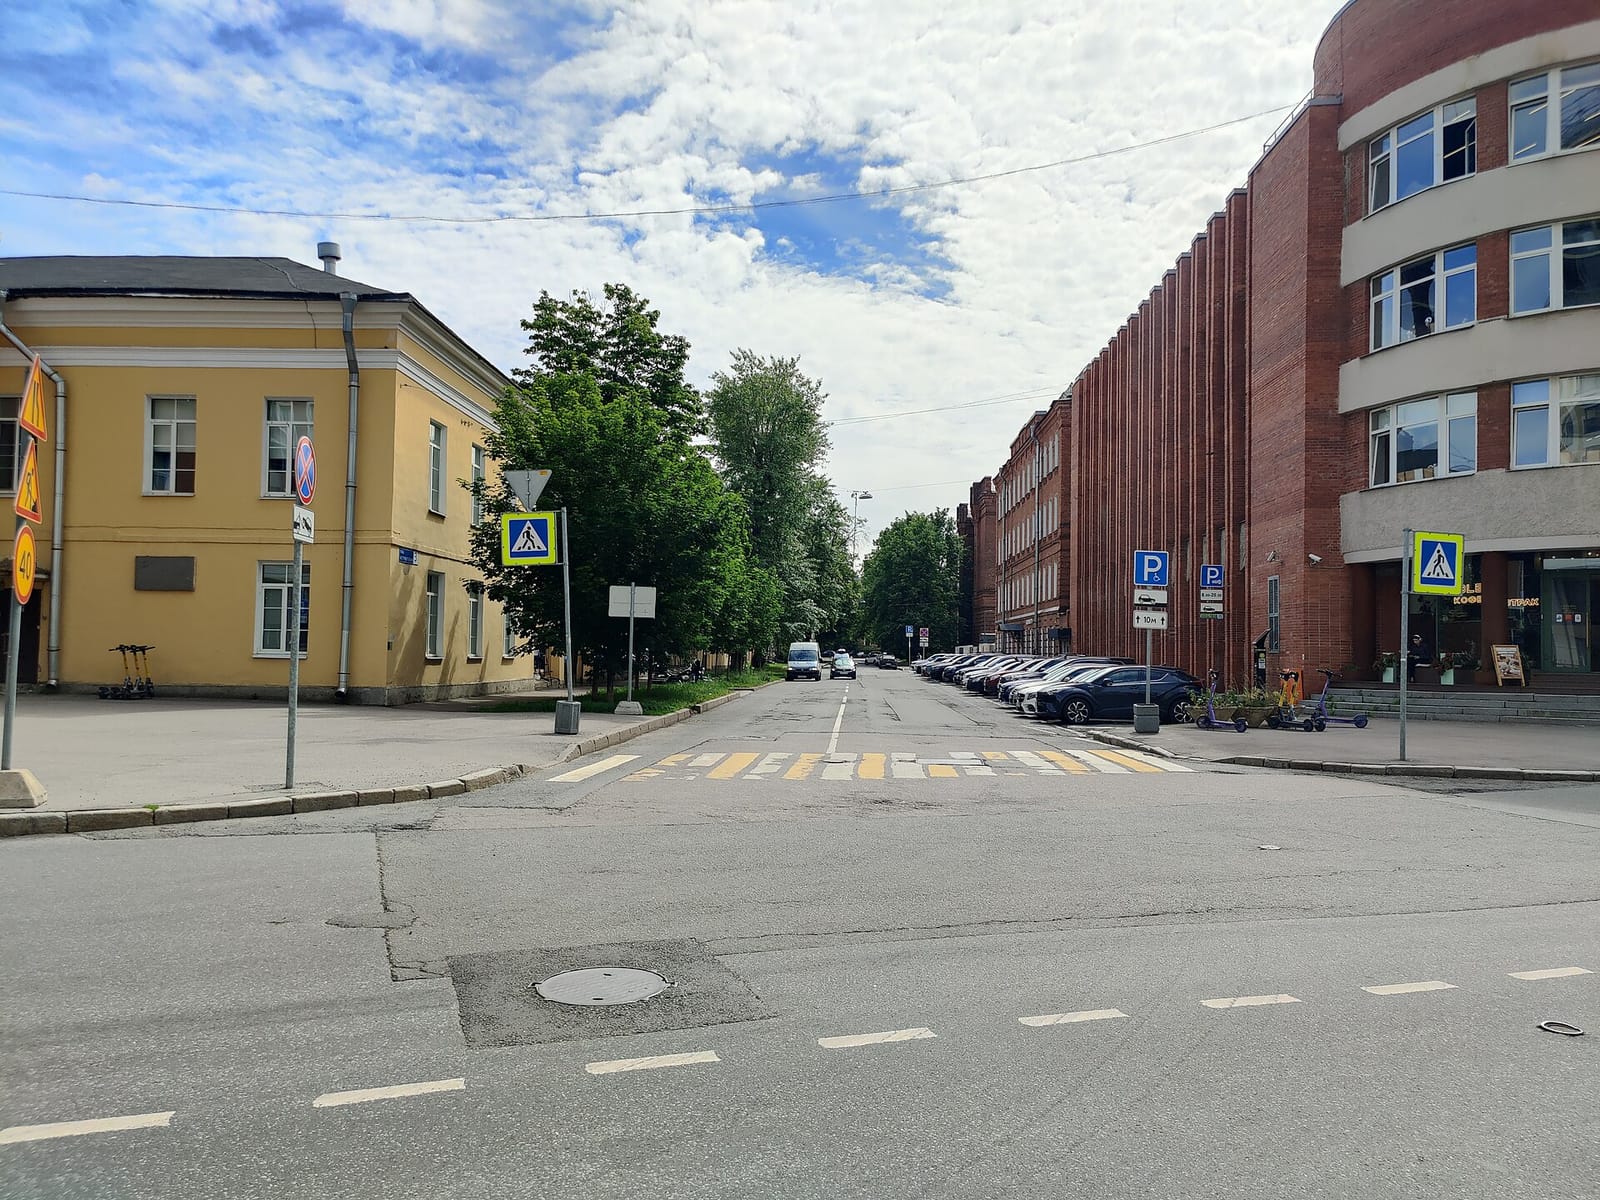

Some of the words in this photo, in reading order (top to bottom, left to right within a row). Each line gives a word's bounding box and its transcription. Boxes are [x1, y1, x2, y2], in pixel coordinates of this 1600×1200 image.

[20, 550, 32, 580] 40
[1143, 555, 1162, 582] P
[1207, 567, 1219, 584] P
